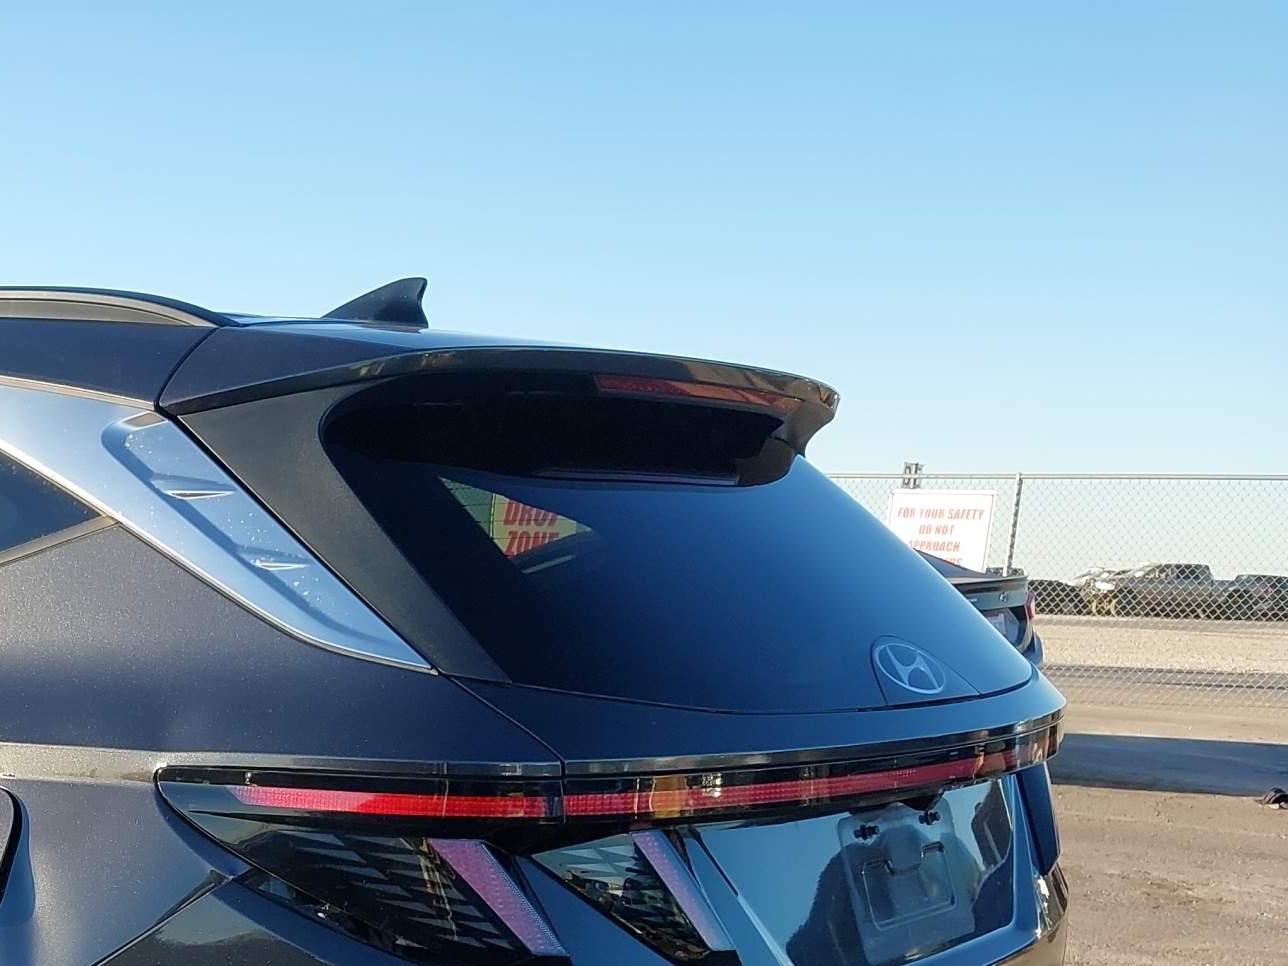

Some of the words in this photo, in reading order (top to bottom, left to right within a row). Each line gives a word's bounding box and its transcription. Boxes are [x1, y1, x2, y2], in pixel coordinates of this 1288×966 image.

[897, 507, 916, 518] FOR
[920, 508, 945, 519] YOUR
[947, 508, 985, 520] SAFETY
[918, 524, 932, 535] DO
[934, 524, 955, 535] NOT
